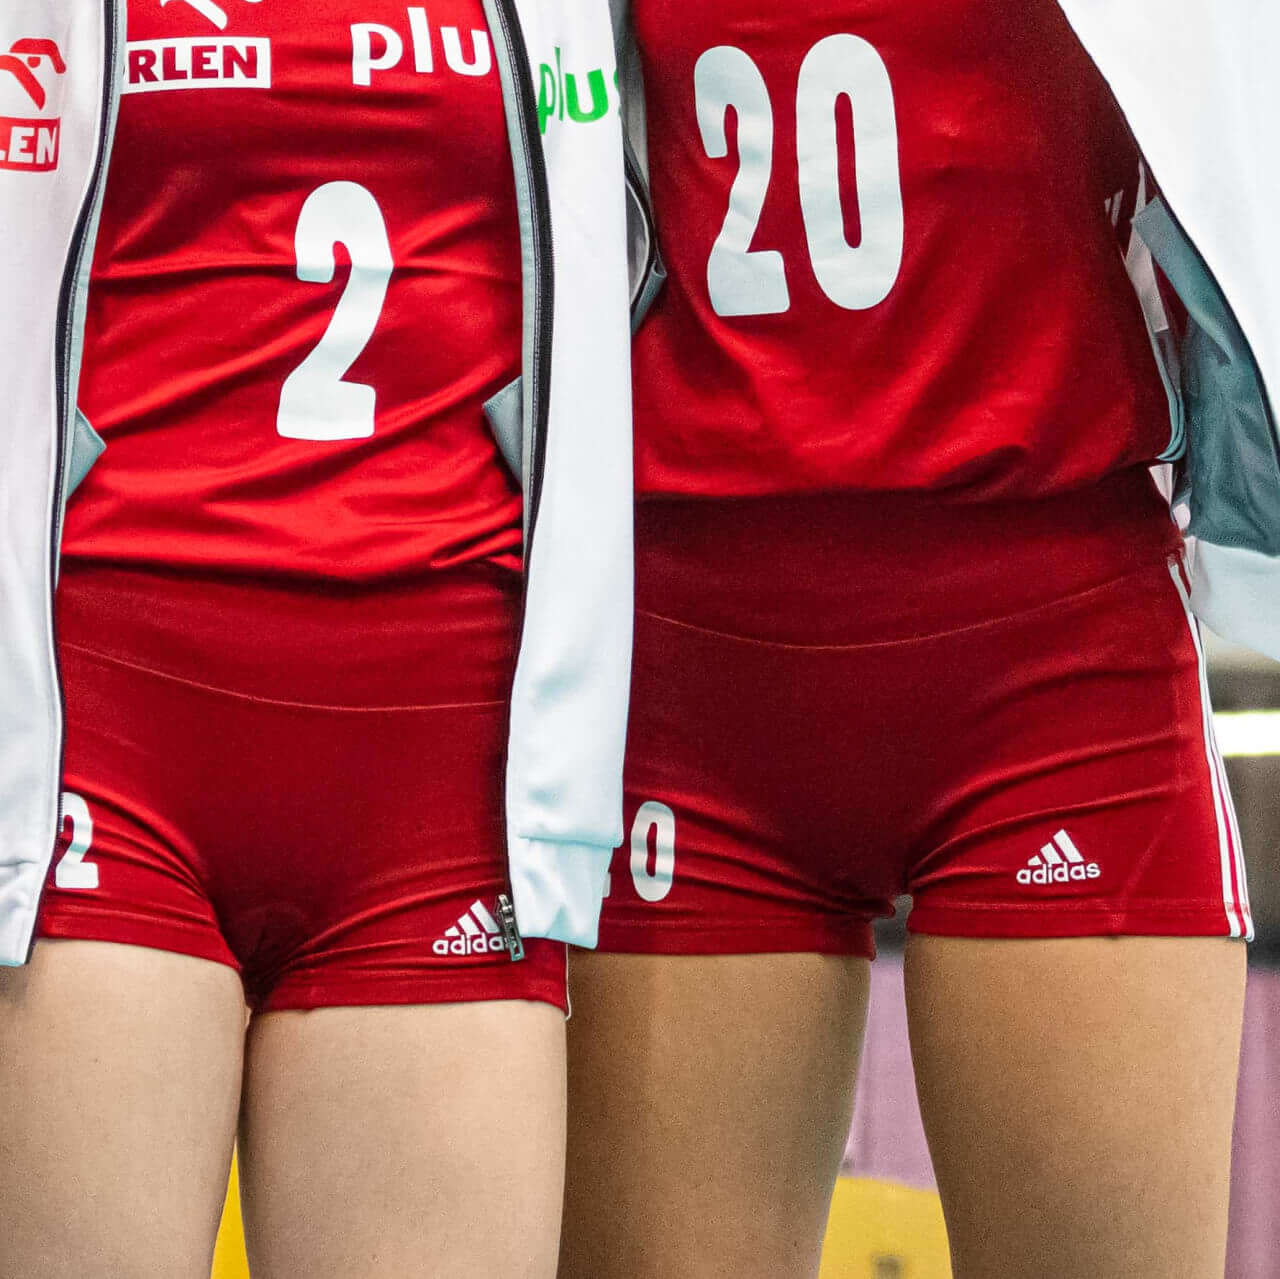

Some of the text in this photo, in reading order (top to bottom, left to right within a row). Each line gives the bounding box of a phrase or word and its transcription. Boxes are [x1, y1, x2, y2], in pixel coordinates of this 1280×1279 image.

[126, 44, 259, 84] RLEN
[537, 46, 619, 136] plu
[694, 32, 904, 317] 20
[276, 180, 394, 441] 2
[56, 791, 99, 889] 2
[1016, 861, 1101, 885] adidas
[432, 931, 508, 956] adida
